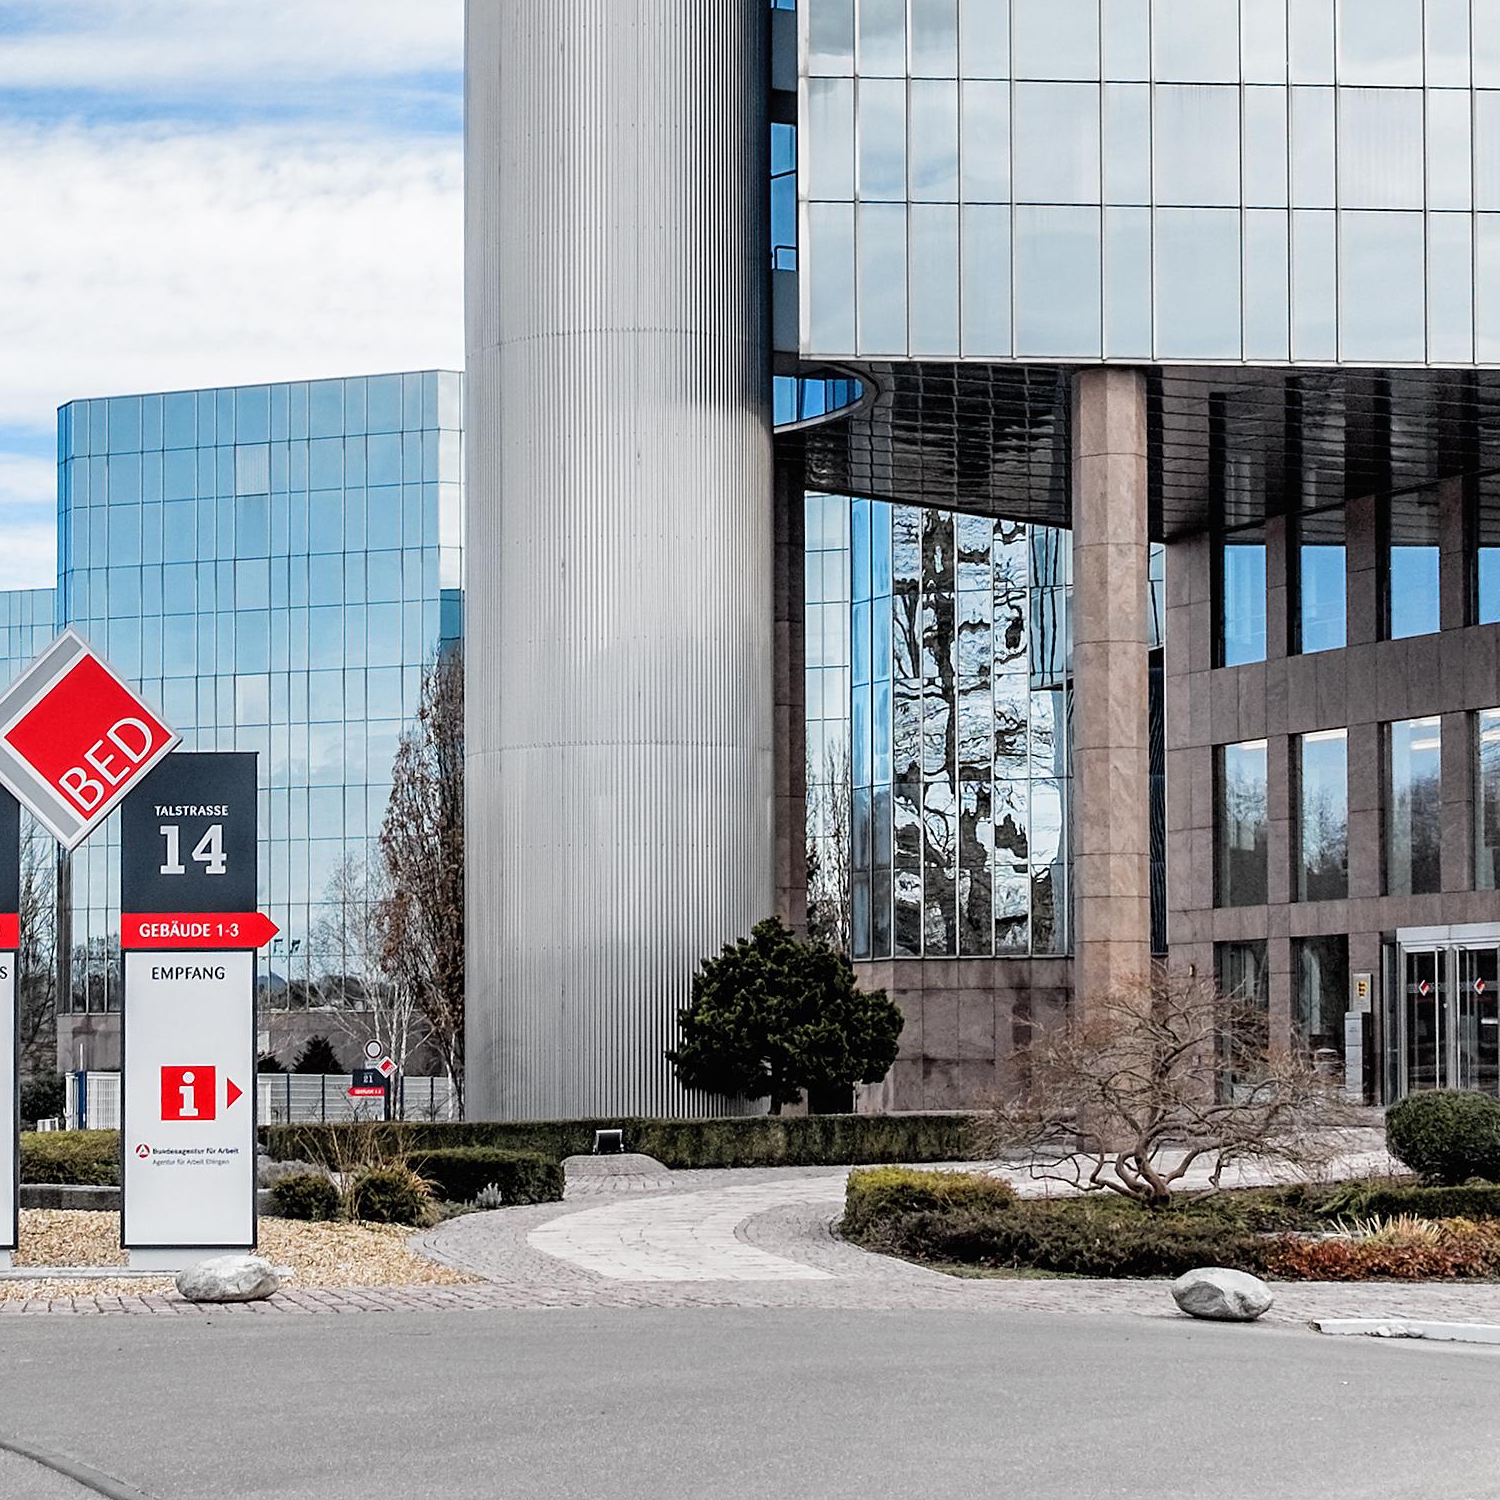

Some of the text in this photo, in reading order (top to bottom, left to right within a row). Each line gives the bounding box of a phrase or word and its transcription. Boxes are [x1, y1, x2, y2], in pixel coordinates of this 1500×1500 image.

[59, 717, 152, 811] BED
[154, 805, 229, 817] TALSTRASSE
[159, 824, 227, 875] 14
[139, 920, 239, 938] GEBÄUDE 1-3
[151, 965, 226, 980] EMPFANG
